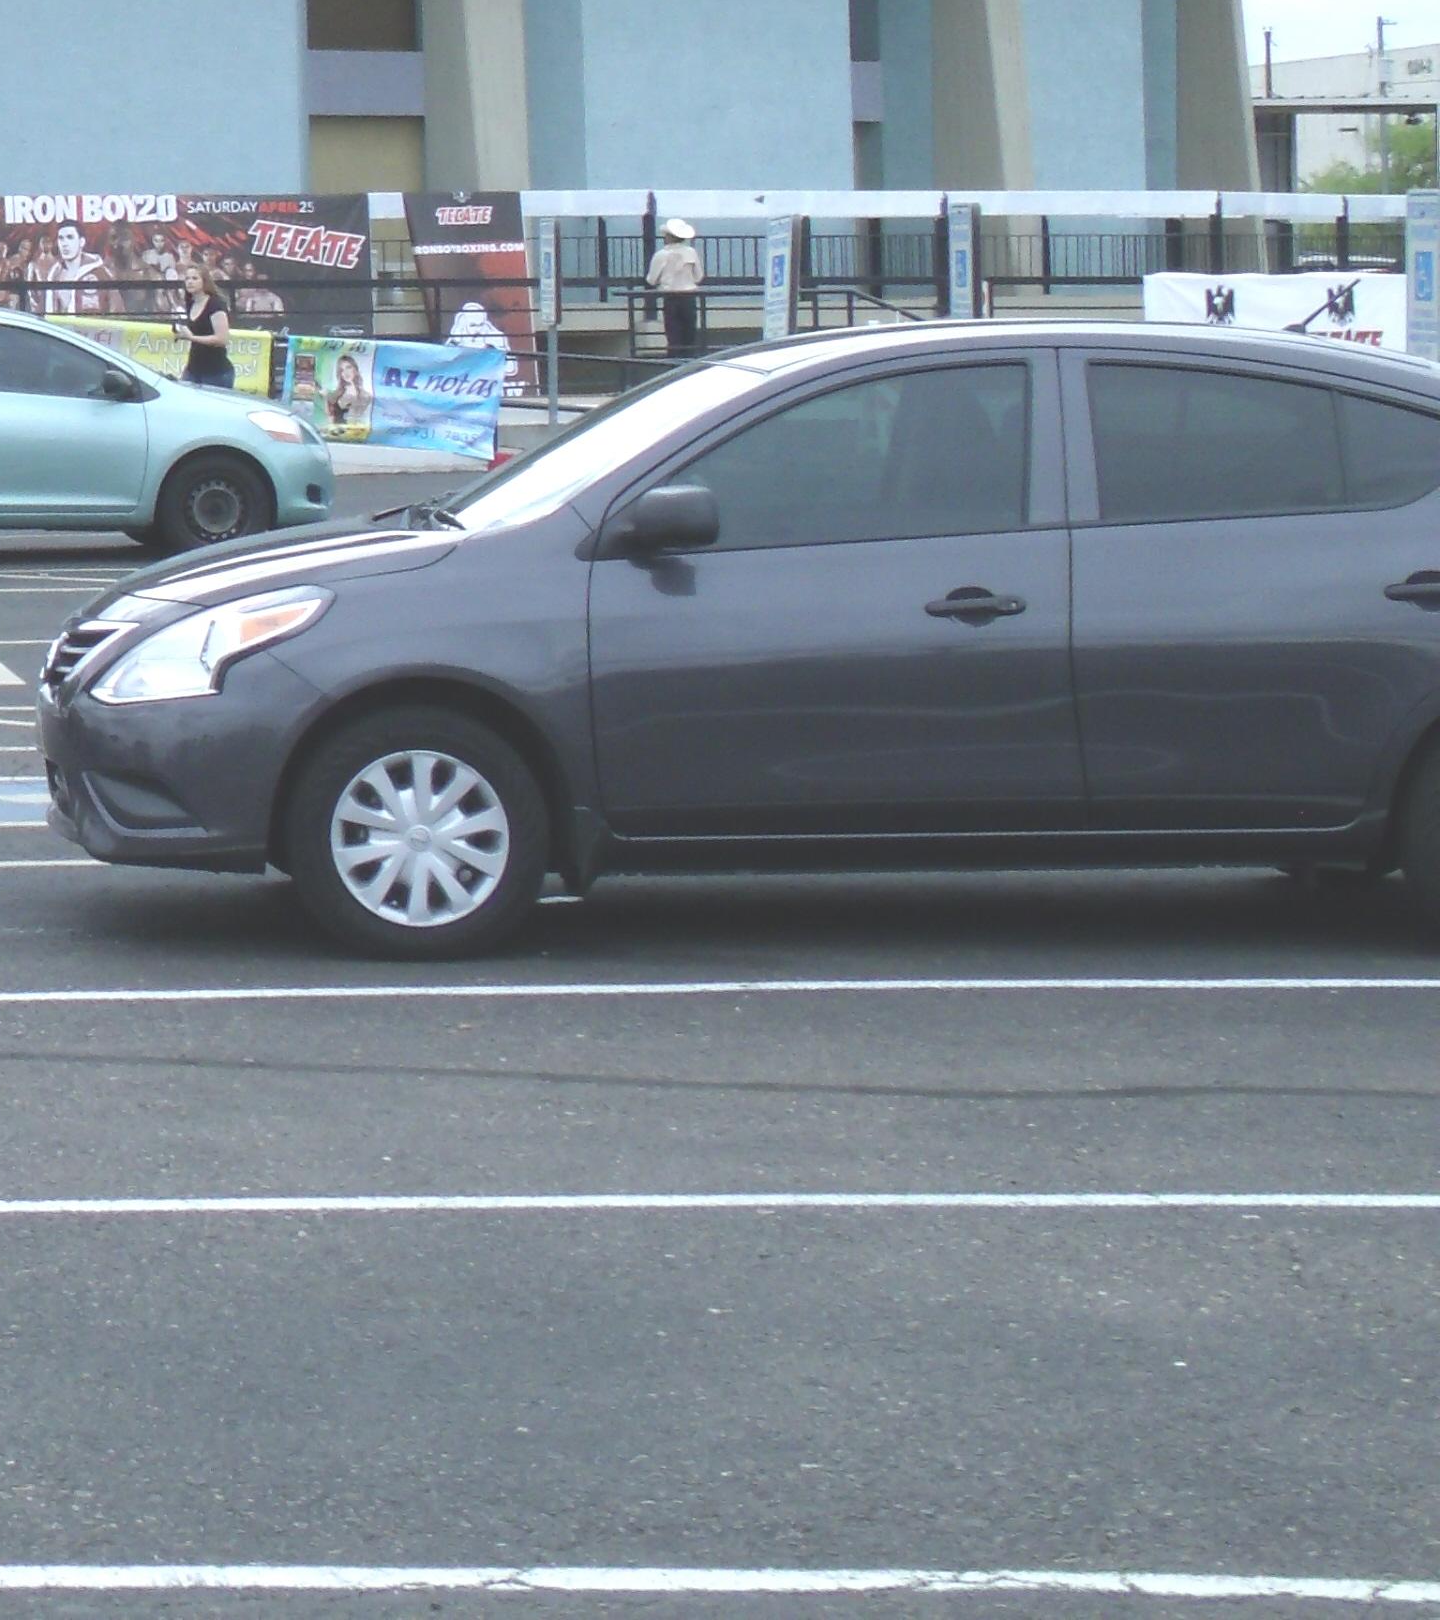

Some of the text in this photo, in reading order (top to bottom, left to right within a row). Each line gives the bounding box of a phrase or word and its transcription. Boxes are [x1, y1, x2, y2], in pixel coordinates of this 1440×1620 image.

[4, 195, 76, 224] IRON
[187, 201, 257, 214] SATURDAY
[299, 201, 315, 213] 25
[436, 206, 493, 225] TECATE
[248, 220, 366, 269] TECATE
[382, 366, 498, 398] AZ notas
